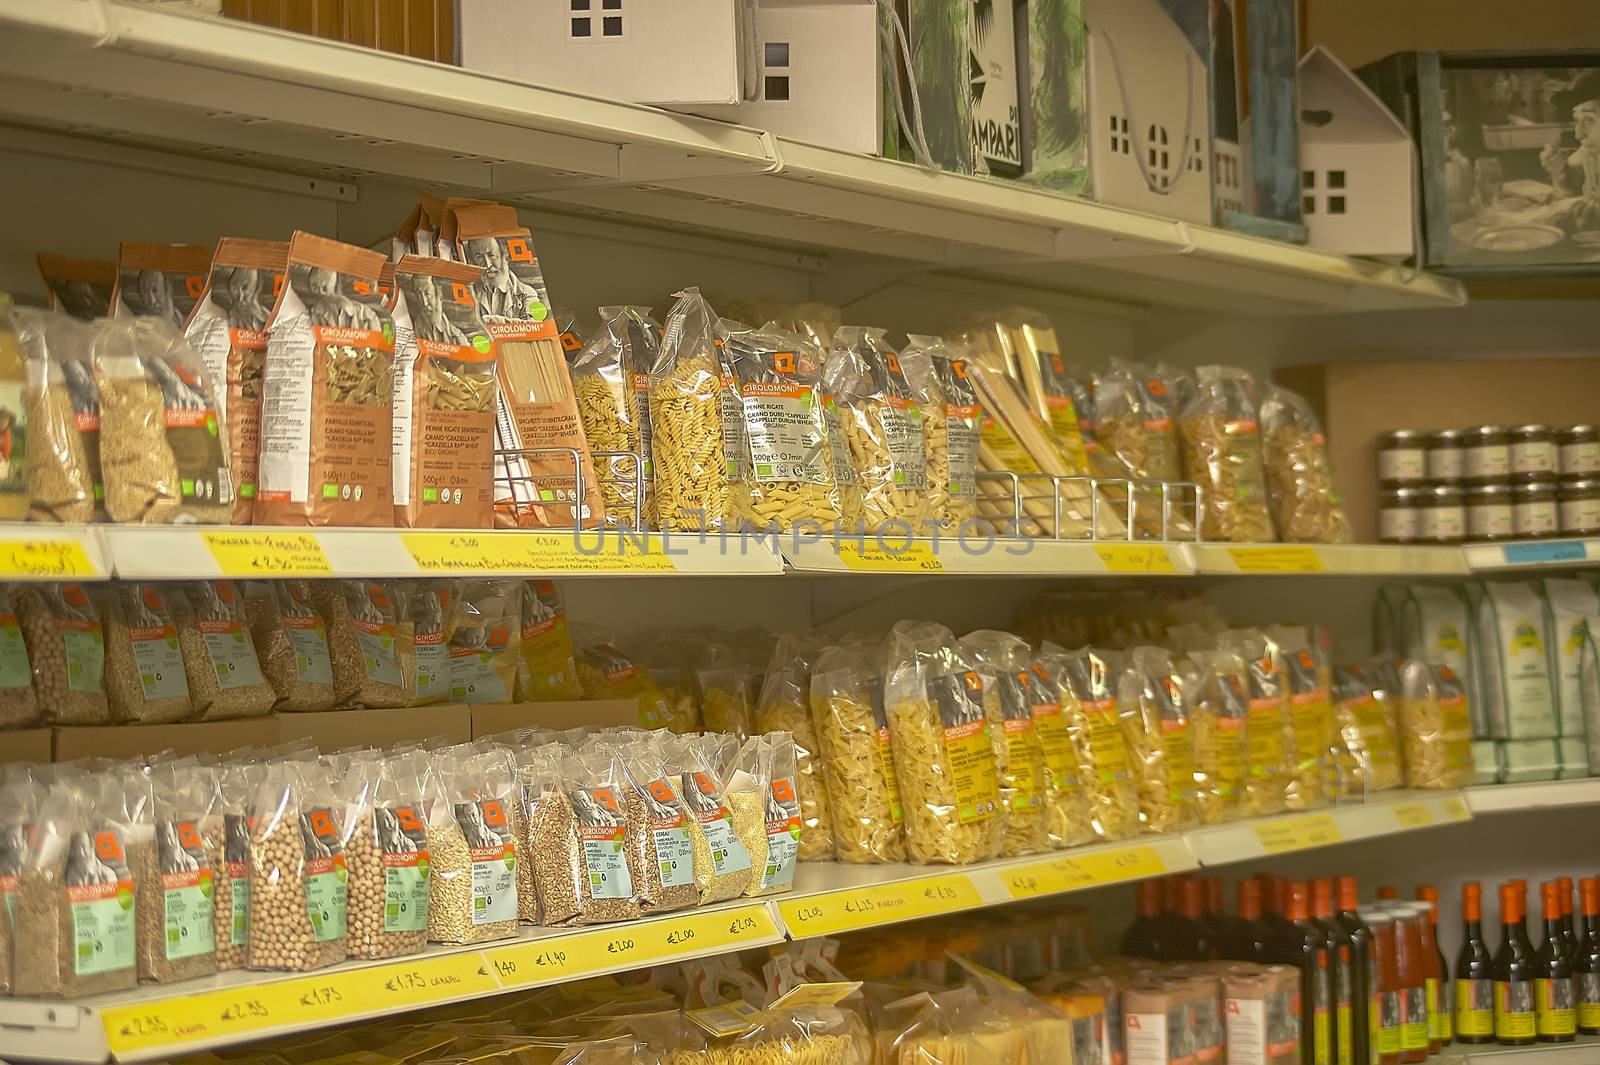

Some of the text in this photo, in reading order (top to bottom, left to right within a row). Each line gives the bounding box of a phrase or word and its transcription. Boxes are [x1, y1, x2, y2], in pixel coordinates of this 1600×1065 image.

[491, 323, 543, 336] GIROLOMONI
[743, 384, 796, 393] GIROLOMONI
[582, 827, 615, 836] GIROLOMONI
[384, 973, 427, 993] €1.75
